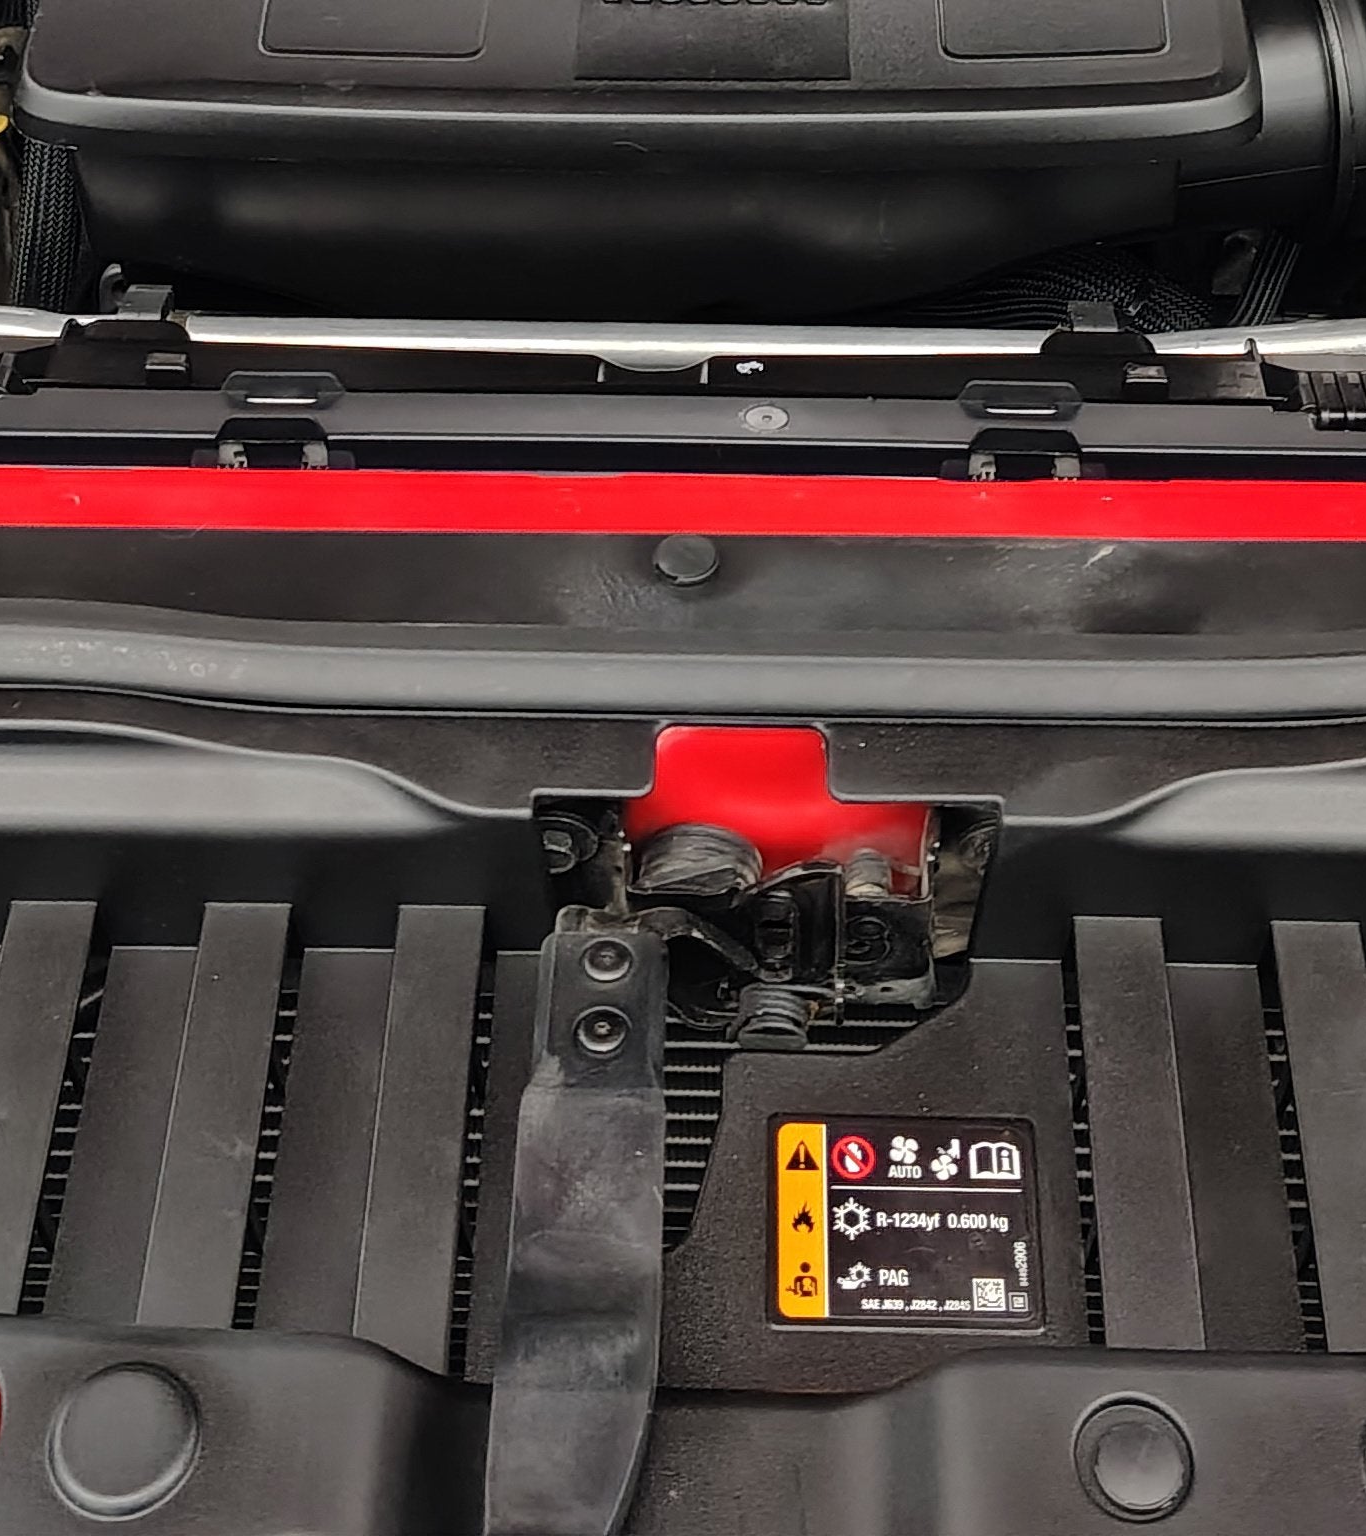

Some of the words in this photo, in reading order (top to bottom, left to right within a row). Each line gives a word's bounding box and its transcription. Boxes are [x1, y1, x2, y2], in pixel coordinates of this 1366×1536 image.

[888, 1165, 922, 1179] AUTO
[876, 1212, 940, 1231] R-1234yf
[947, 1213, 987, 1229] 0.600
[990, 1213, 1009, 1232] kg
[879, 1269, 909, 1286] PAG
[861, 1299, 880, 1310] SAE
